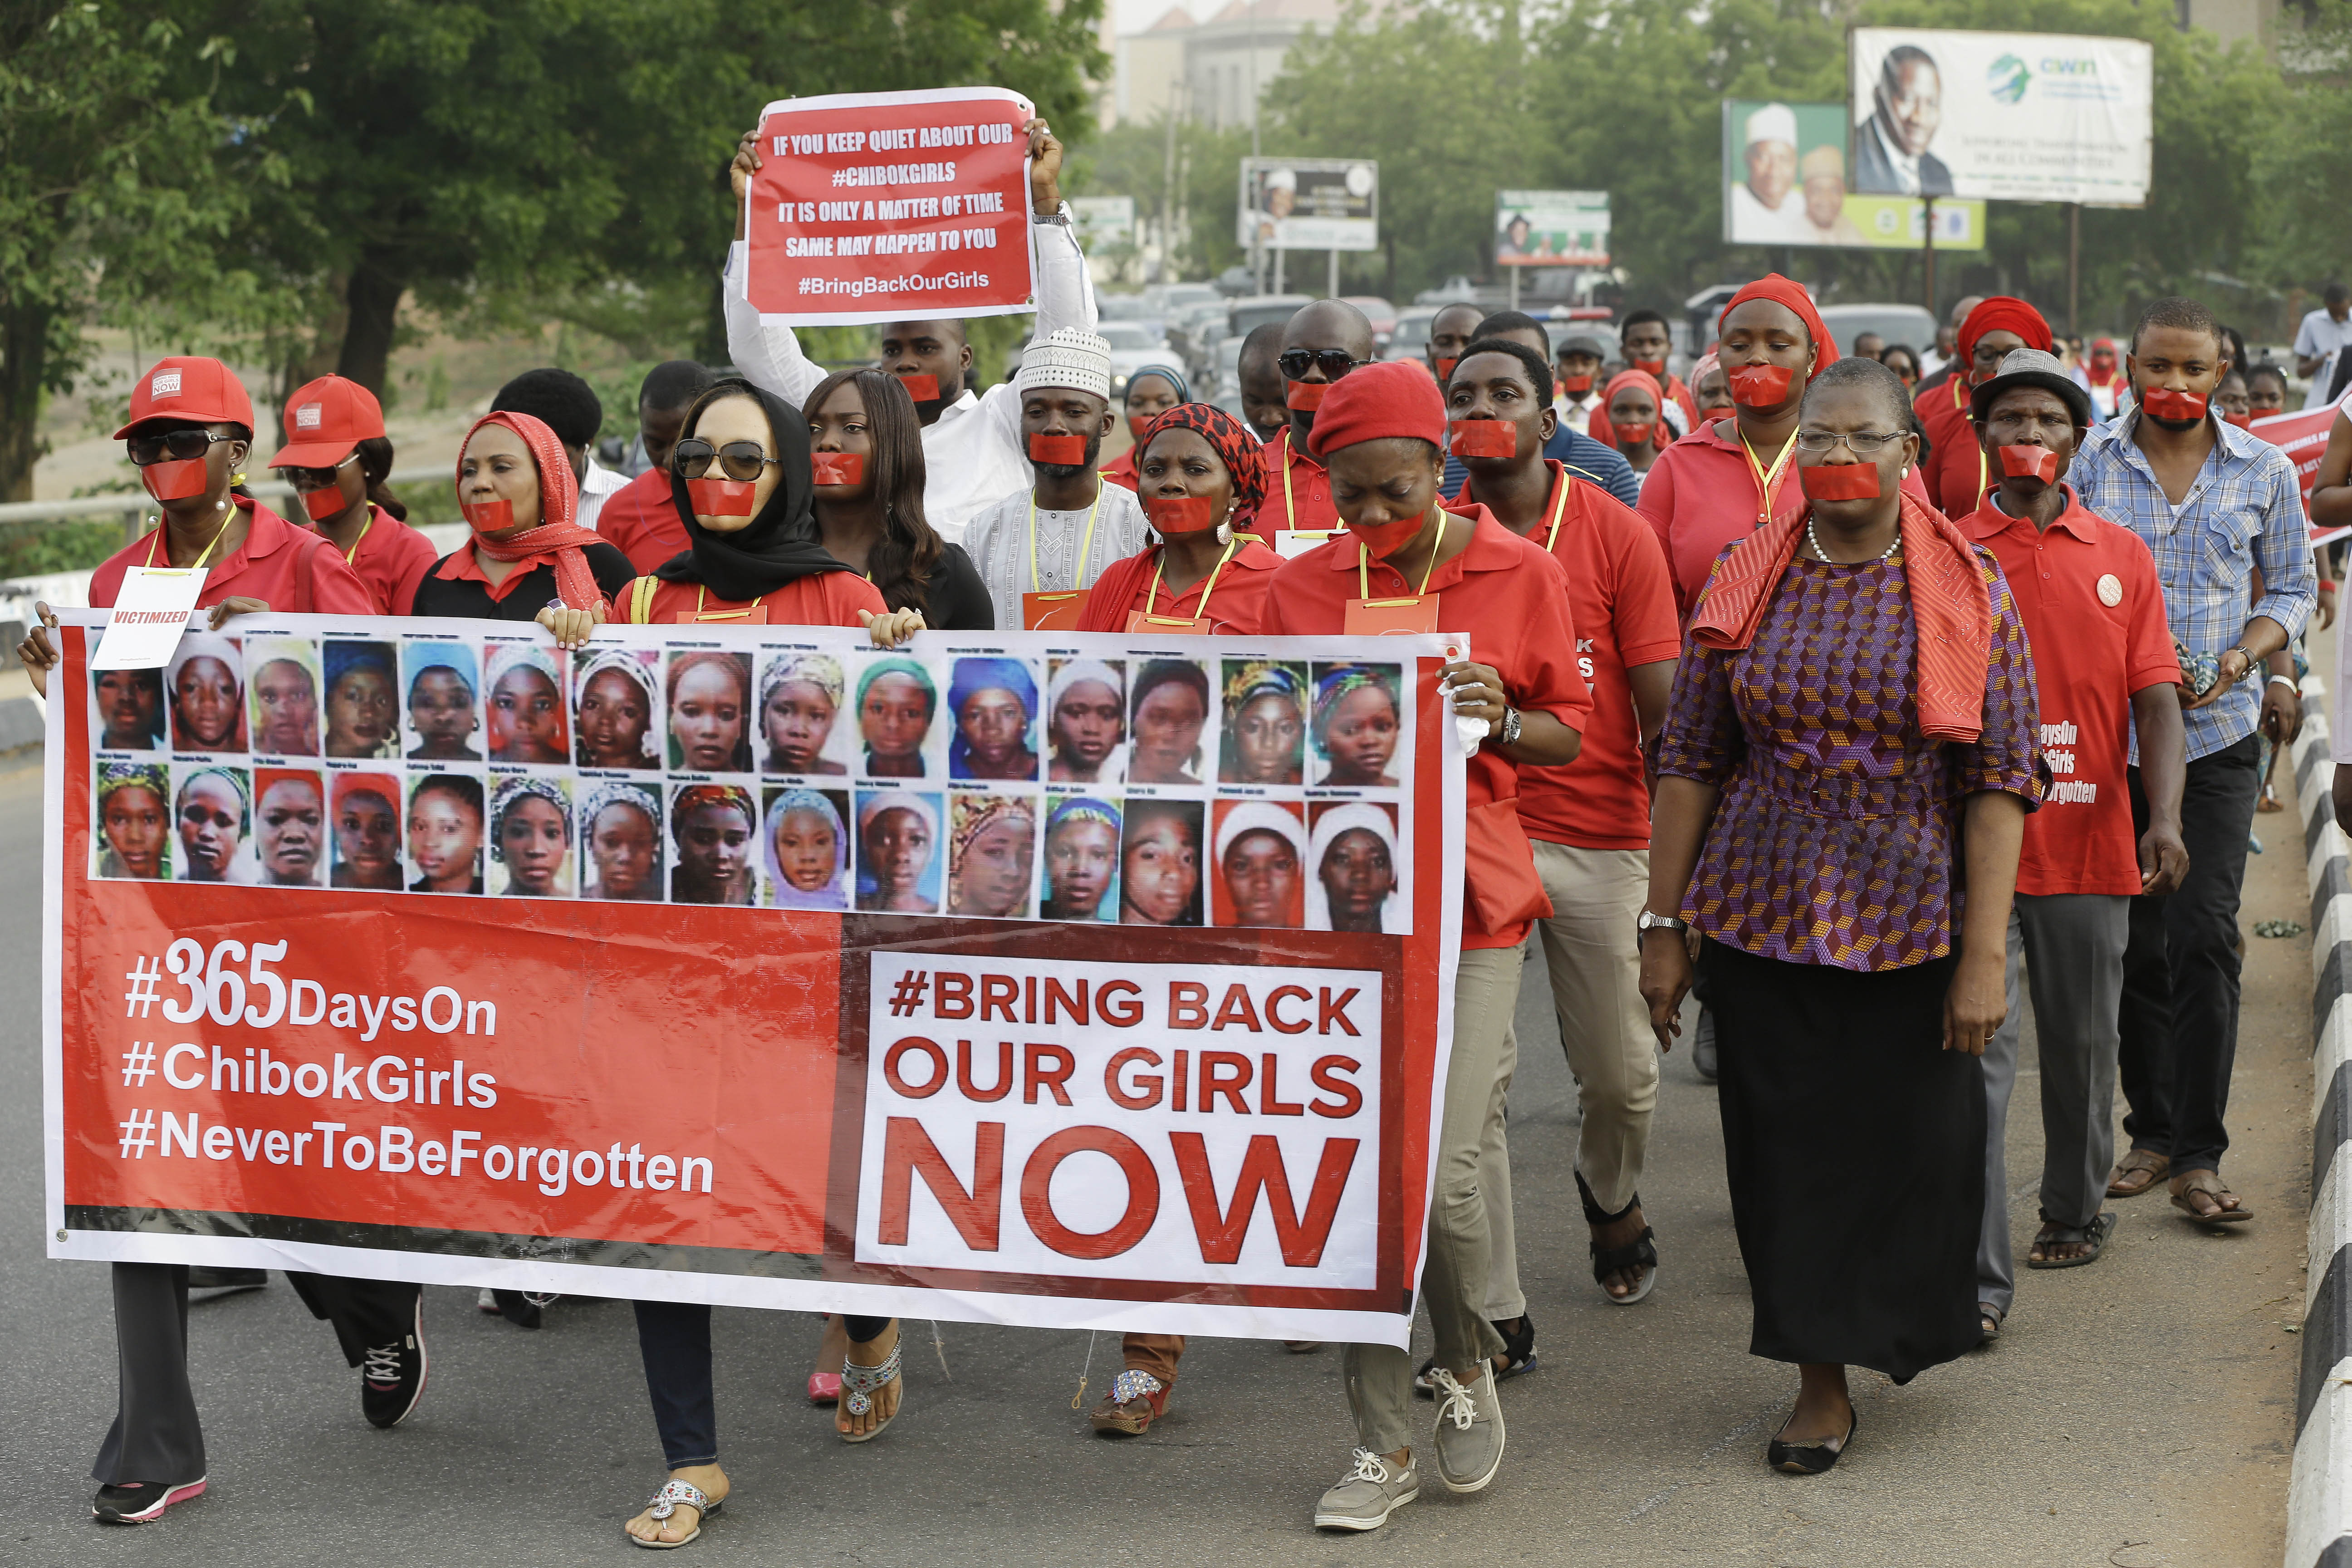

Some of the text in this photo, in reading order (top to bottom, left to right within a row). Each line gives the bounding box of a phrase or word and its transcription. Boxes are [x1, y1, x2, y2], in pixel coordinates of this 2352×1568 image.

[773, 123, 1013, 157] IF YOU KEEP QUIET ABOUT OUR
[832, 162, 956, 187] #CHIBOKGIRLS
[778, 192, 1004, 223] IT IS ONLY A MATTER OF TIME
[785, 228, 997, 258] SAME MAY HAPPEN TO YOU
[799, 271, 990, 297] #BringBackOurGirls
[153, 382, 179, 394] NOW
[297, 416, 319, 426] NOW
[2100, 579, 2110, 589] Our
[2100, 588, 2116, 604] NOW!
[114, 611, 188, 624] VICTIMIZED
[2040, 720, 2078, 747] aysOn
[124, 937, 496, 1042] #365DaysOn
[888, 970, 1362, 1037] #BRING BACK
[122, 1040, 498, 1109] #ChibokGirls
[883, 1035, 1363, 1119] OUR GIRLS
[118, 1107, 713, 1197] #NeverToBeForgotten
[877, 1116, 1361, 1268] NOW
